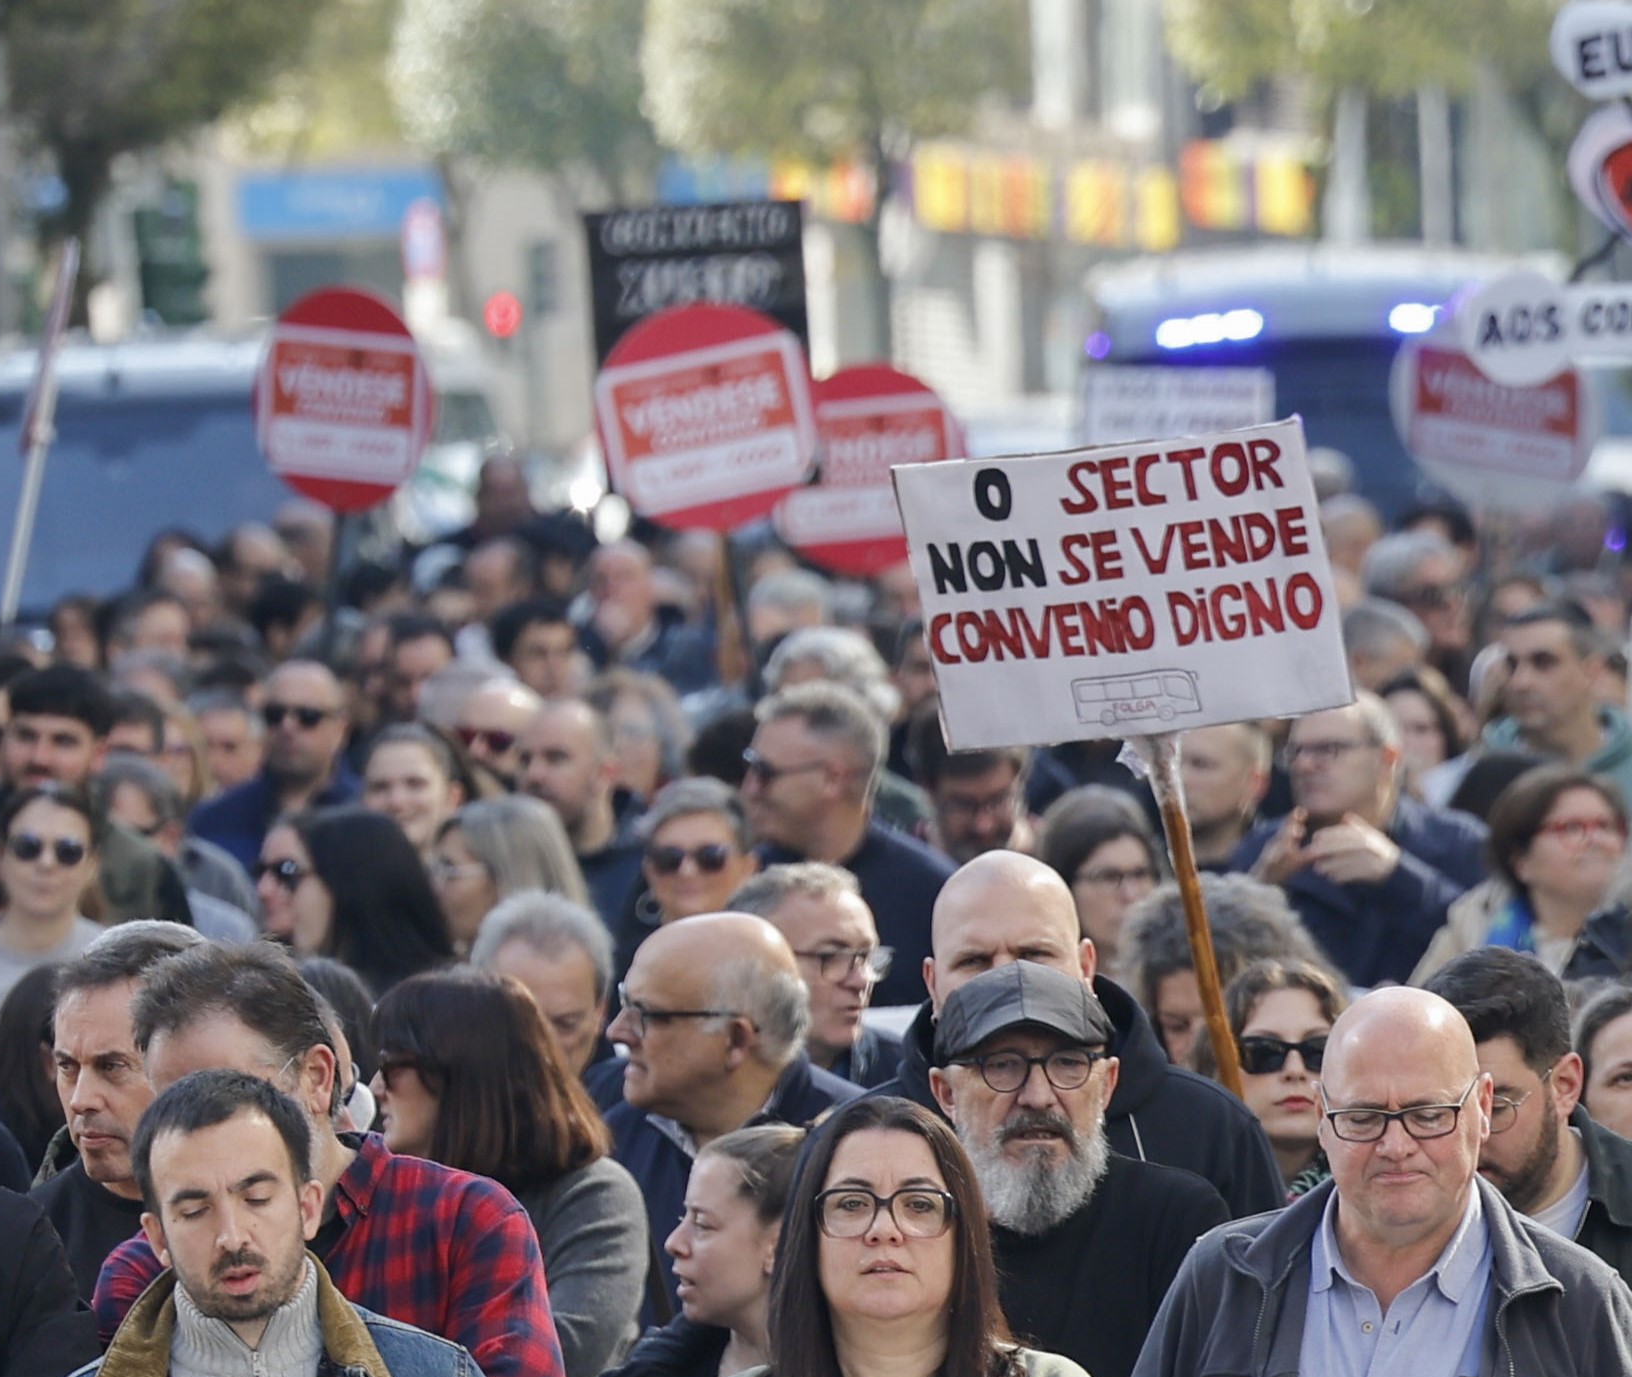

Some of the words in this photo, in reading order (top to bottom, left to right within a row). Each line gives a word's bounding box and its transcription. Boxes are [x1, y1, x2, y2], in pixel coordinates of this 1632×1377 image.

[1479, 310, 1562, 350] AOS
[974, 467, 1012, 521] O
[1060, 439, 1284, 514] SECTOR
[927, 538, 1047, 594] NON
[1058, 530, 1124, 586] SE
[1130, 506, 1310, 576] VENDE
